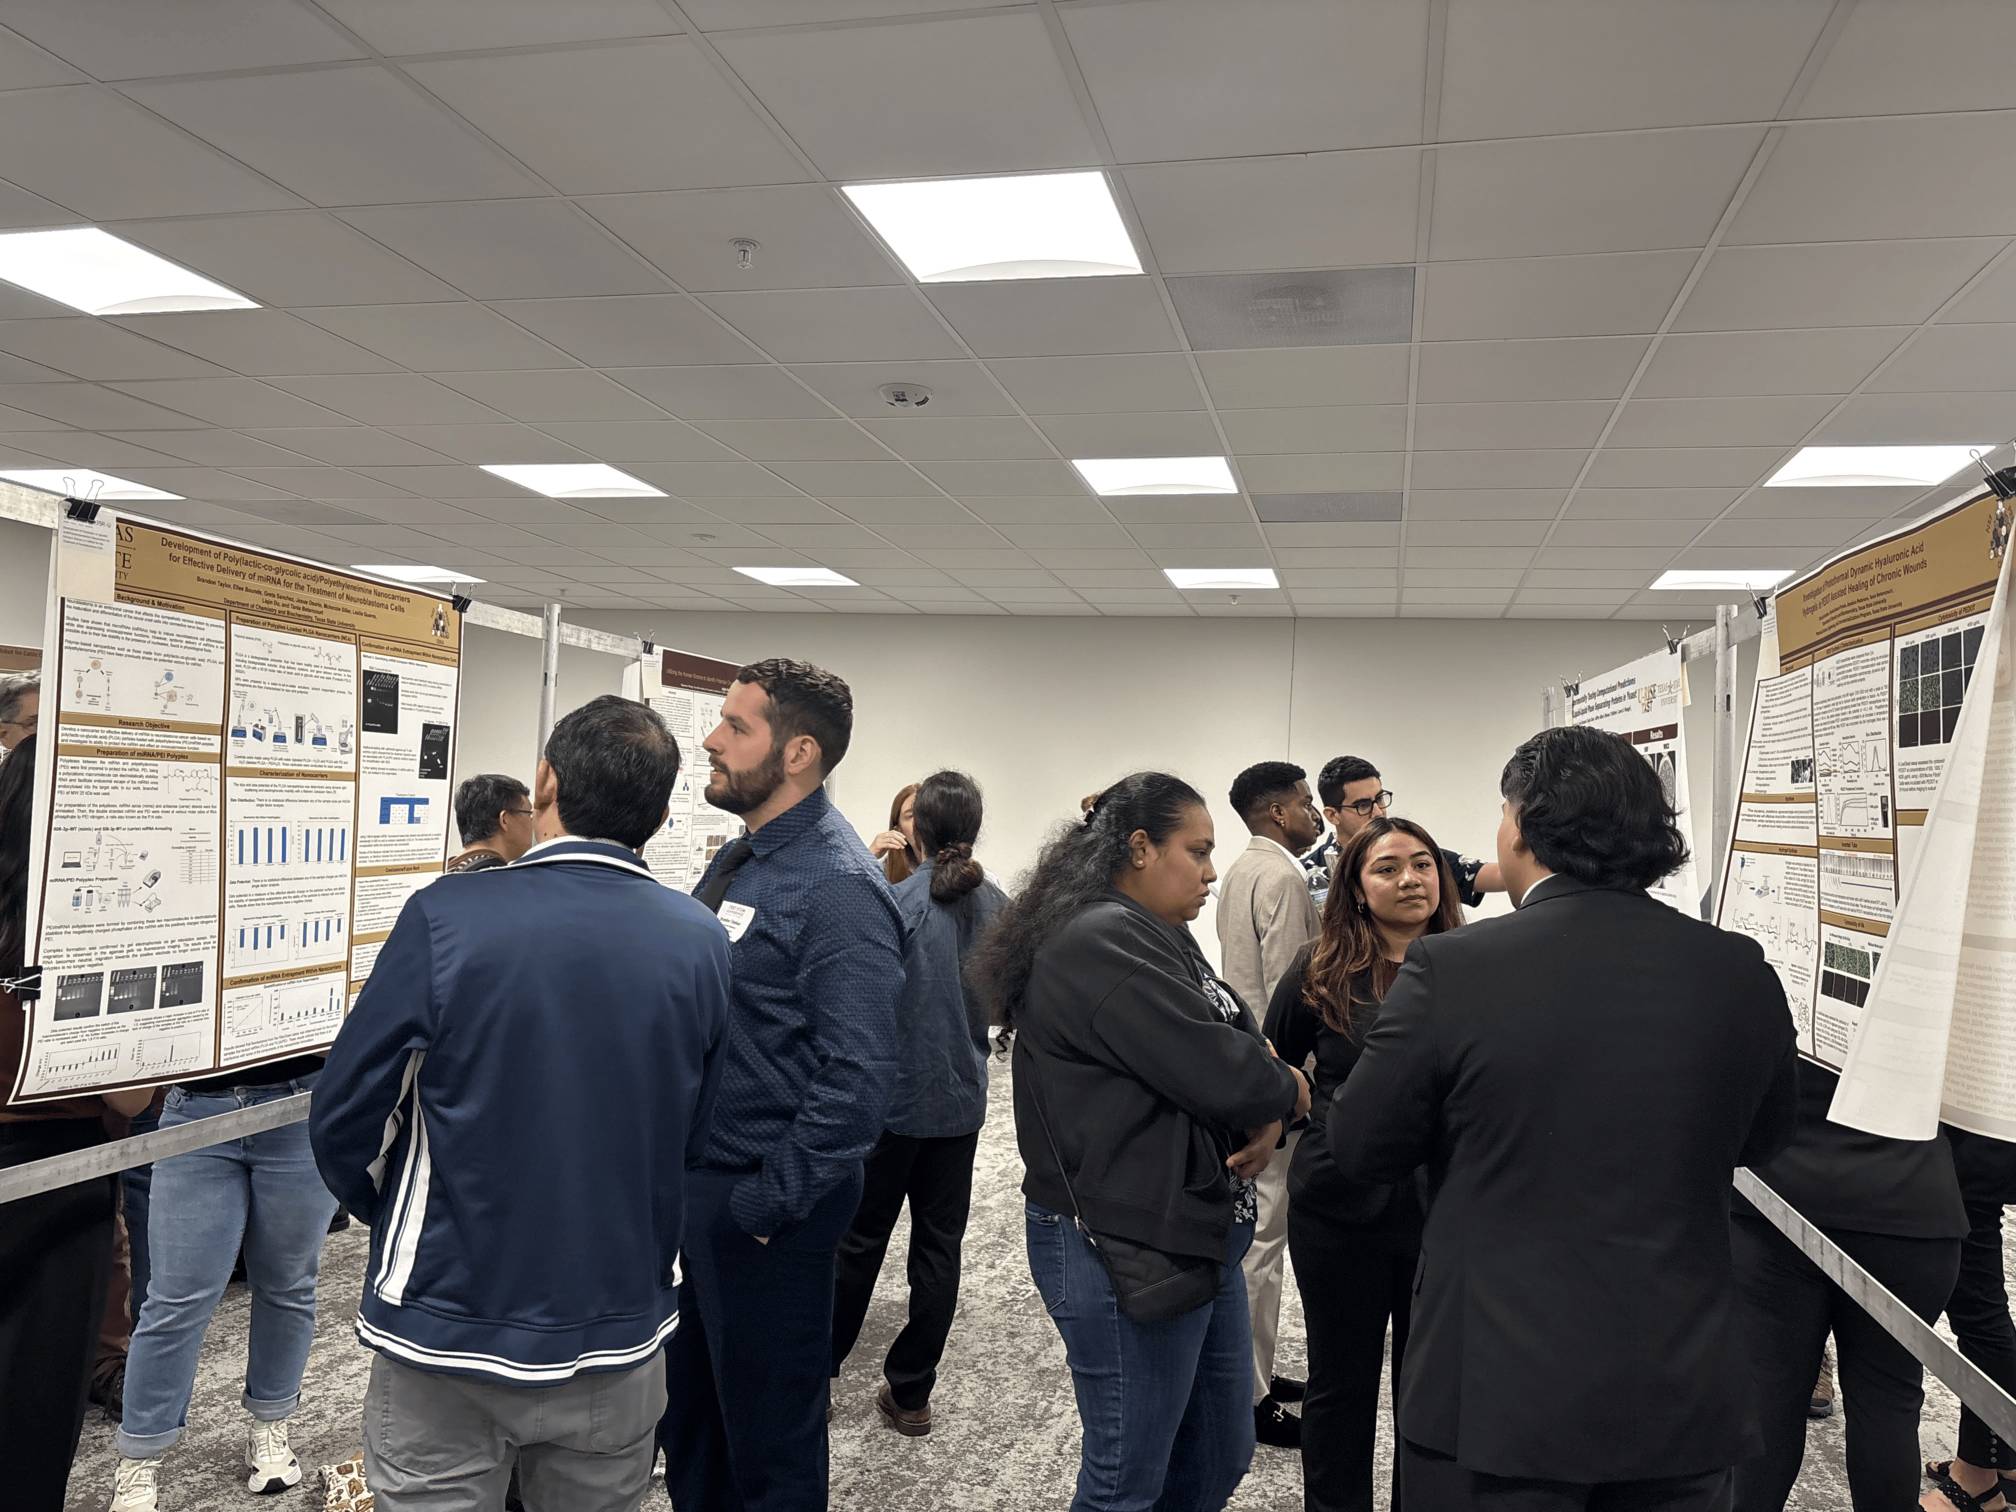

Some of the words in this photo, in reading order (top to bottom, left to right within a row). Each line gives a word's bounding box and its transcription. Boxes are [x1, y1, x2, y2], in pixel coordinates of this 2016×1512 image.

[161, 537, 212, 558] Development
[374, 589, 410, 604] Nanocarriers
[1848, 580, 1868, 594] Healing
[1870, 577, 1876, 587] of
[1877, 570, 1901, 584] Chronic
[1903, 559, 1927, 576] Wounds
[1850, 562, 1873, 578] Dynamic
[1874, 548, 1910, 568] Hyaluronic
[1911, 540, 1924, 556] Acid
[116, 594, 150, 605] Background
[158, 600, 185, 610] Motivation
[169, 553, 180, 562] for
[183, 557, 214, 572] Effective
[217, 564, 246, 580] Delivery
[248, 572, 256, 580] of
[258, 575, 281, 586] miRNA
[284, 580, 292, 588] for
[294, 582, 304, 591] the
[307, 584, 336, 598] Treatment
[346, 594, 388, 610] Neuroblastoma
[390, 604, 404, 613] Cells
